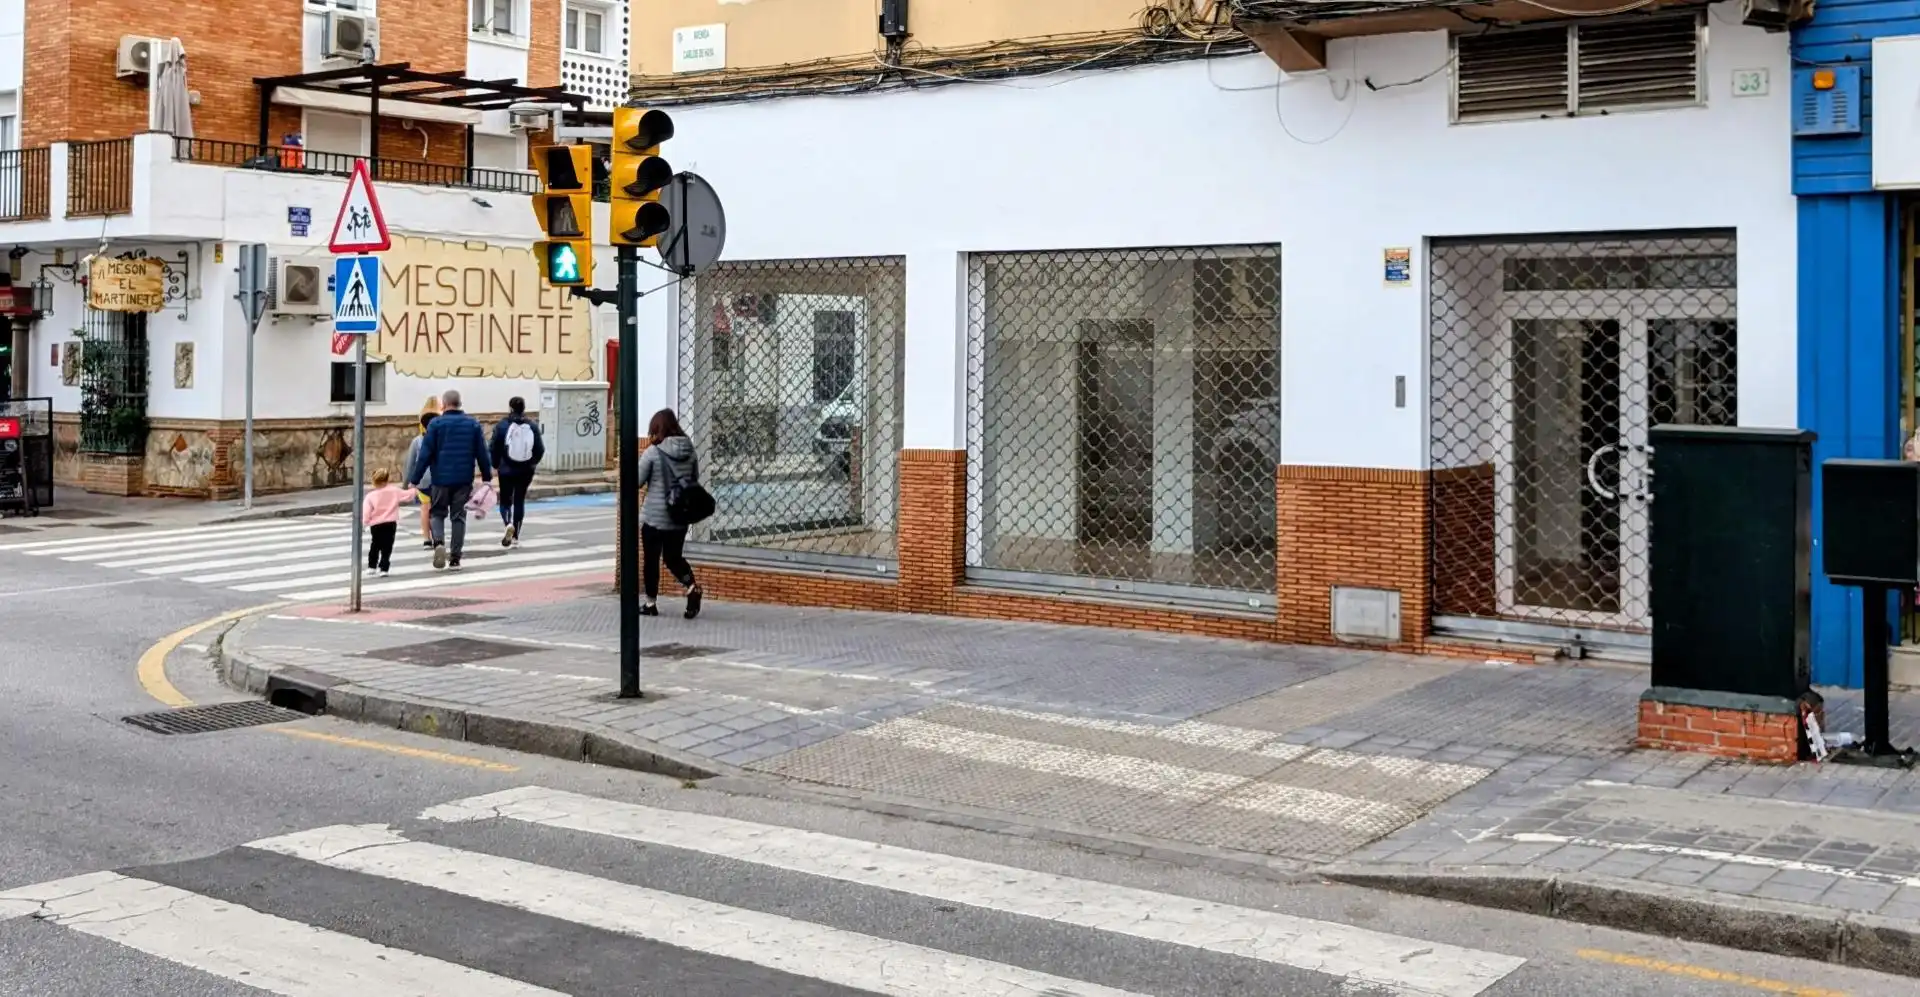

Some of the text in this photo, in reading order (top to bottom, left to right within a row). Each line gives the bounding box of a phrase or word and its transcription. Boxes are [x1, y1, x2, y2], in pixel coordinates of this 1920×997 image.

[1739, 72, 1761, 91] 33
[107, 263, 147, 275] MESON
[119, 278, 136, 290] EL
[381, 263, 516, 309] MESON
[538, 277, 574, 311] EL
[94, 292, 159, 306] MARTINETE
[378, 310, 574, 355] MARTINETE
